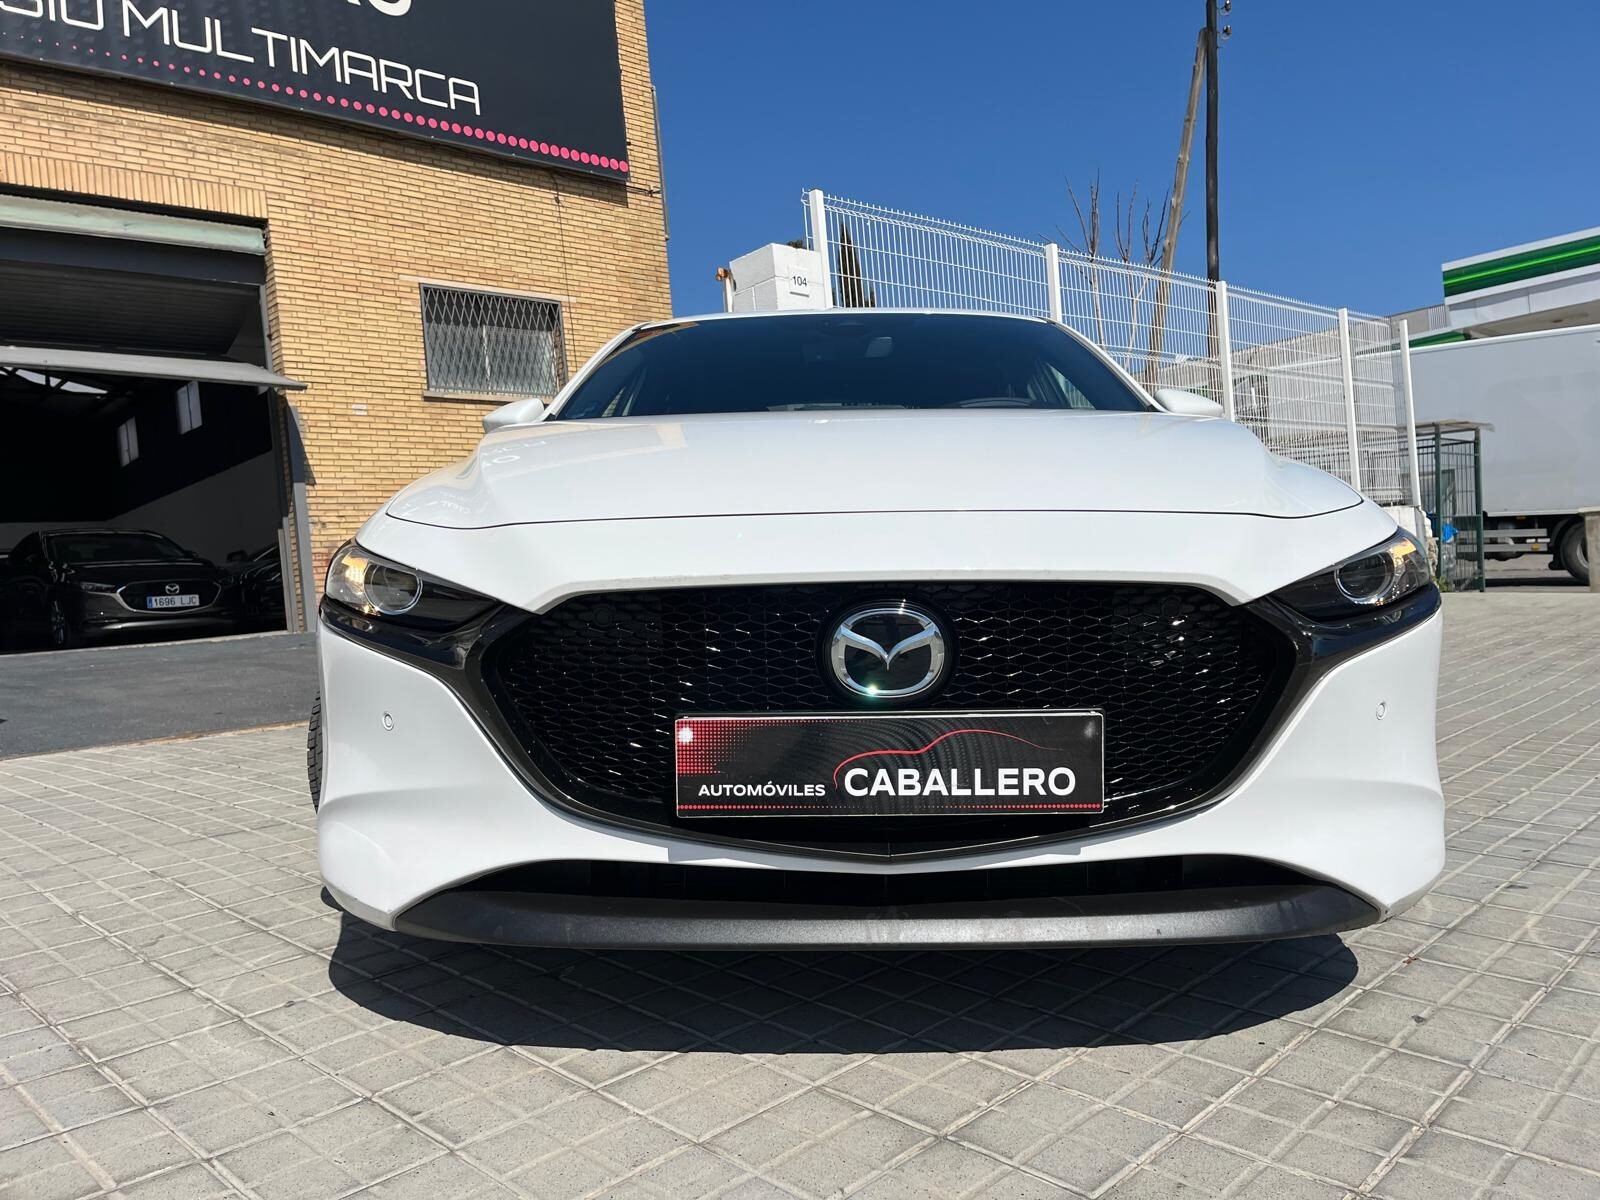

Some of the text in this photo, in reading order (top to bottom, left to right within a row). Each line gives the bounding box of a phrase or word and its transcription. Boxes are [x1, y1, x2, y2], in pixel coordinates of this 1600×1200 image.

[121, 0, 480, 116] MULTIMARCA
[791, 275, 807, 287] 104
[154, 597, 176, 607] 1696
[698, 767, 1076, 797] AUTOMÓVILES CABALLERO
